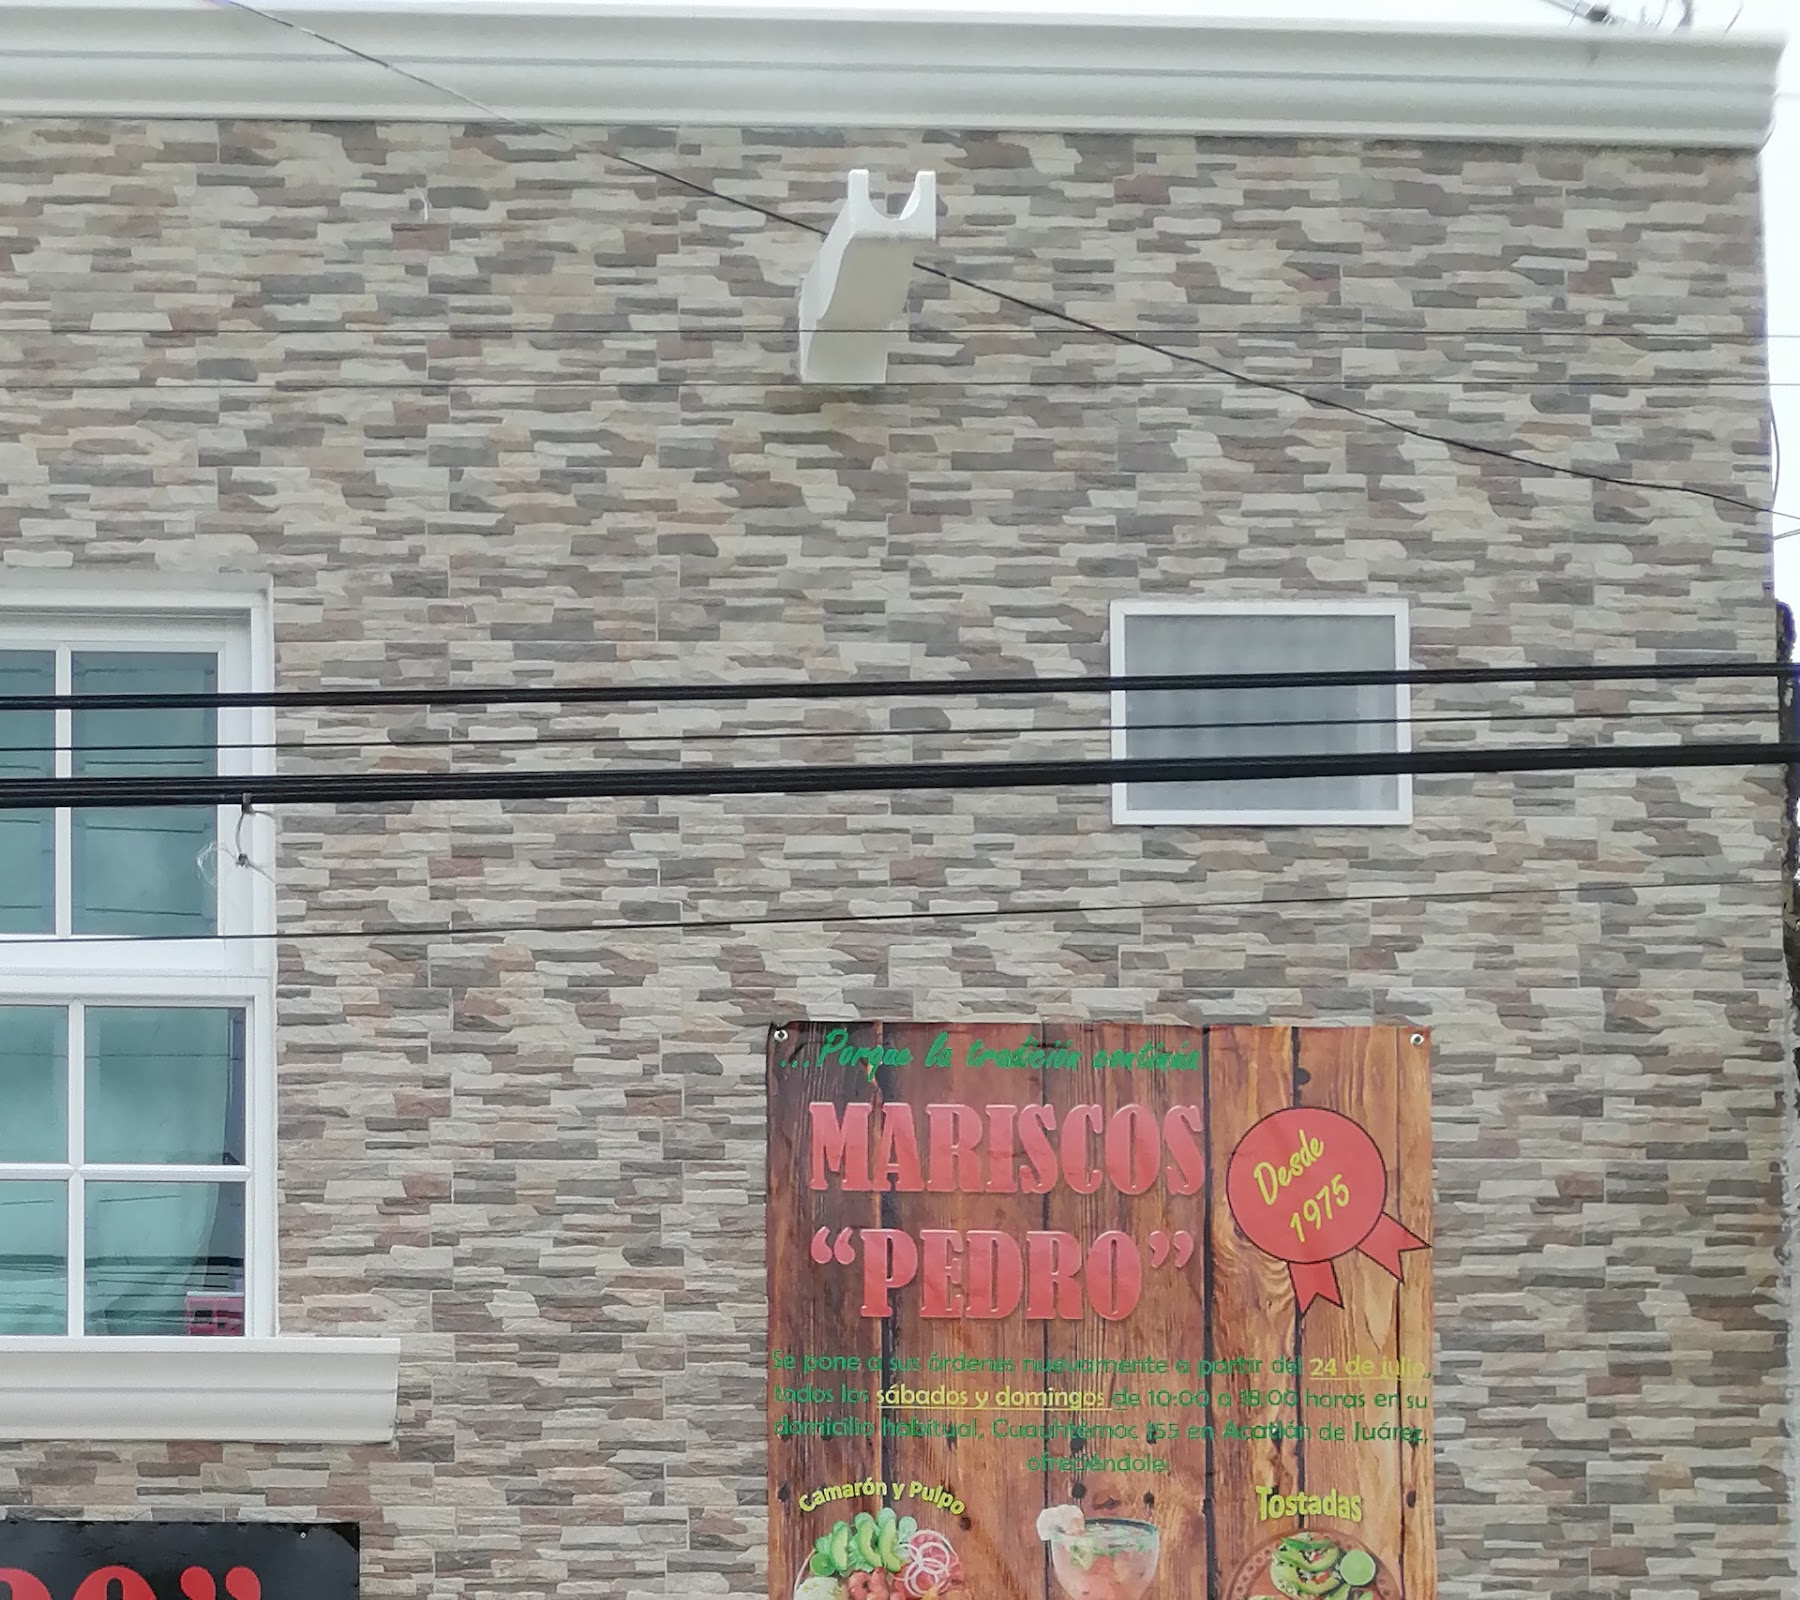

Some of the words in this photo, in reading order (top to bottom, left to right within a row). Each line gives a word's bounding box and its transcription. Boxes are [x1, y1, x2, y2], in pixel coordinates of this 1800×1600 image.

[925, 1031, 952, 1068] la
[966, 1035, 1081, 1071] tradición
[1092, 1040, 1200, 1071] continúa
[809, 1101, 1206, 1196] MARISCOS
[1253, 1128, 1324, 1206] Desde
[1290, 1173, 1350, 1242] 1975
[810, 1225, 1195, 1322] “PEDRO”
[772, 1349, 796, 1370] Se
[803, 1355, 862, 1375] pone
[867, 1356, 882, 1371] a
[889, 1356, 920, 1372] sus
[928, 1351, 1016, 1373] órdenes
[1022, 1355, 1168, 1374] nuevamente
[1175, 1359, 1190, 1374] a
[1198, 1355, 1263, 1378] partir
[1271, 1354, 1303, 1375] del
[1309, 1357, 1337, 1376] 24
[1344, 1354, 1374, 1376] de
[1380, 1354, 1432, 1380] julio,
[774, 1383, 834, 1403] todos
[841, 1382, 869, 1404] los
[876, 1383, 968, 1406] sábados
[975, 1390, 989, 1409] y
[995, 1385, 1105, 1410] domingos
[1111, 1387, 1140, 1407] de
[1148, 1389, 1210, 1407] 10:00
[1217, 1393, 1232, 1407] a
[1240, 1389, 1299, 1407] 18:00
[1304, 1388, 1366, 1408] horas
[1374, 1392, 1400, 1408] en
[1406, 1394, 1428, 1409] su
[774, 1415, 875, 1437] domicilio
[882, 1416, 984, 1440] habitual,
[992, 1417, 1138, 1440] Cuauhtémoc
[1146, 1421, 1179, 1440] 155
[1187, 1424, 1216, 1440] en
[1222, 1418, 1311, 1441] Acatlán
[1318, 1421, 1346, 1441] de
[1354, 1421, 1429, 1445] Juárez,
[798, 1477, 888, 1513] Camarón
[892, 1482, 906, 1501] y
[908, 1480, 966, 1515] Pulpo
[1255, 1485, 1362, 1522] Tostadas
